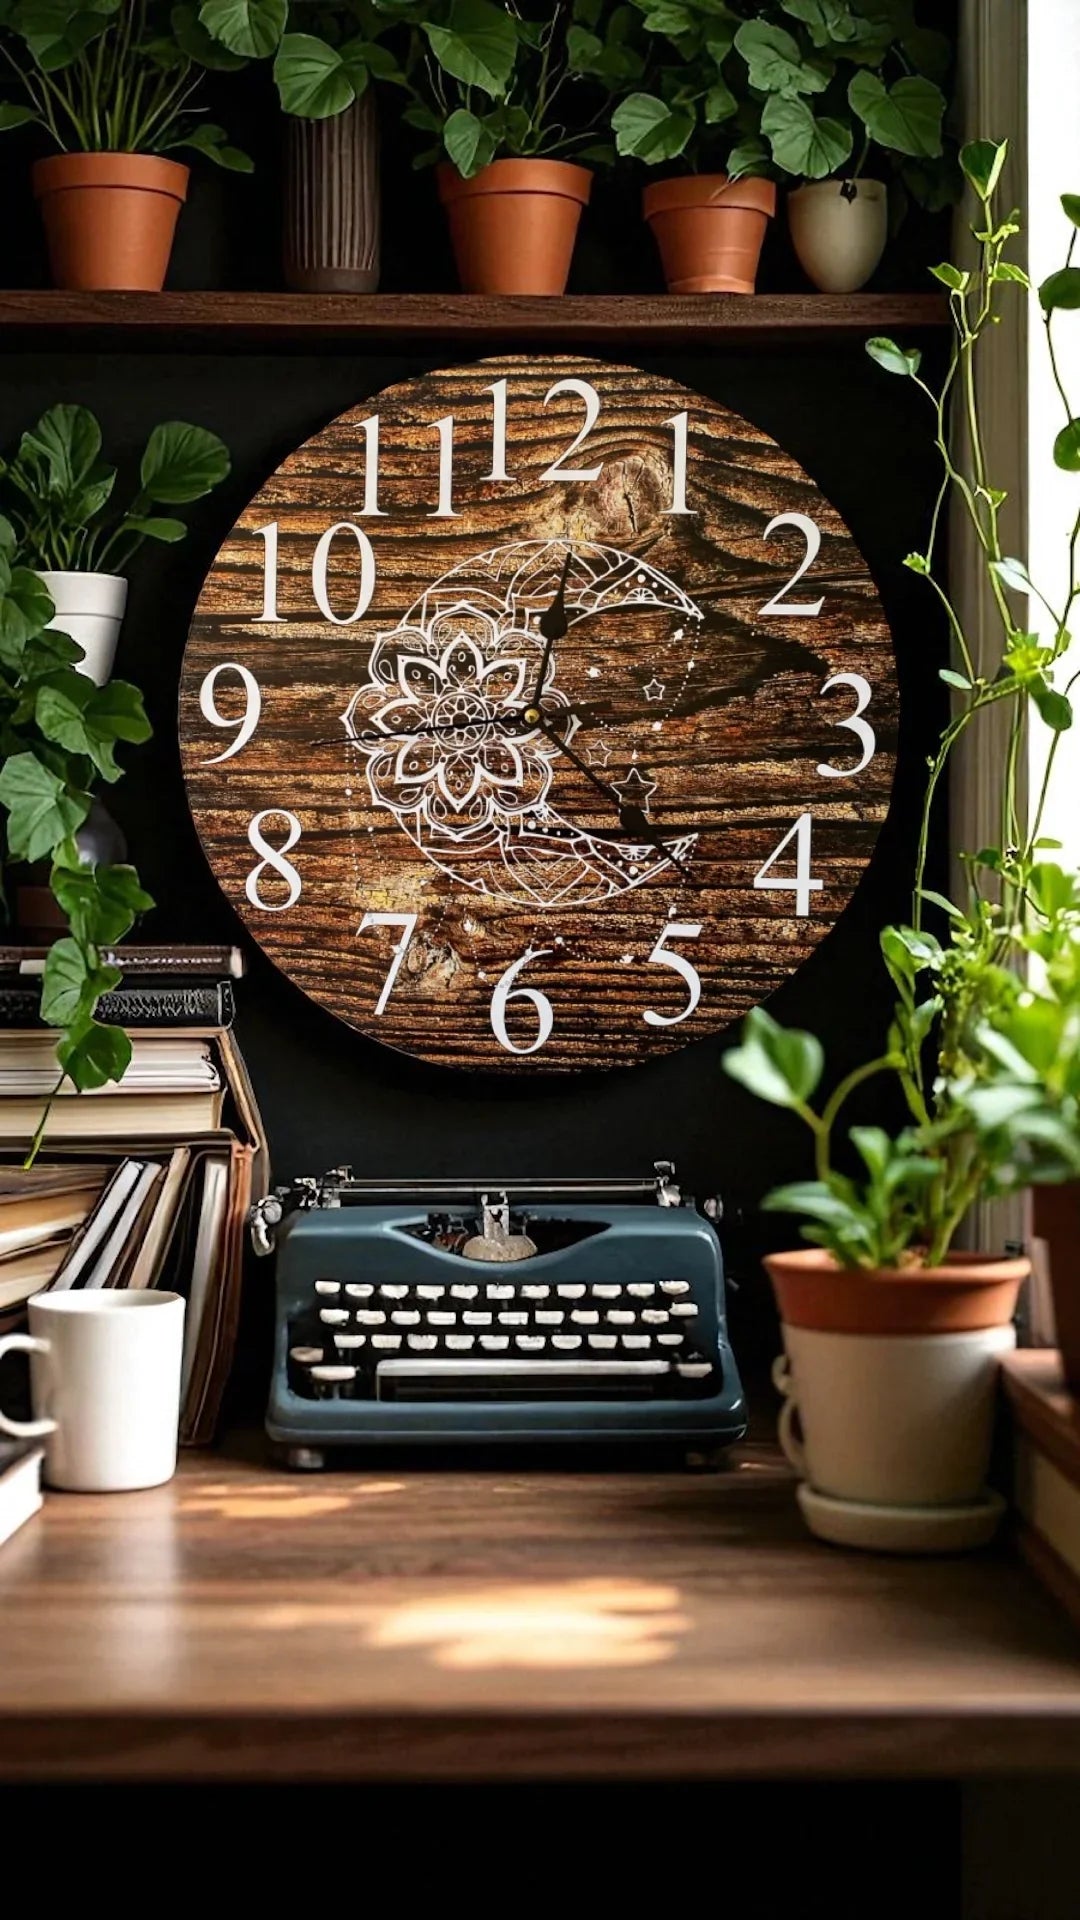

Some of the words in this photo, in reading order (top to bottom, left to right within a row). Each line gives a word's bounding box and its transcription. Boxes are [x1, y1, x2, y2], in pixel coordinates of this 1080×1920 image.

[352, 414, 463, 517] 11
[479, 378, 604, 481] 12
[660, 411, 698, 514] 1
[251, 521, 376, 625] 10
[757, 512, 825, 616] 2
[199, 662, 262, 765] 9
[816, 672, 876, 778] 3
[245, 808, 302, 912] 8
[753, 812, 824, 916] 4
[355, 912, 418, 1016] 7
[490, 945, 554, 1054] 6
[642, 923, 703, 1026] 5
